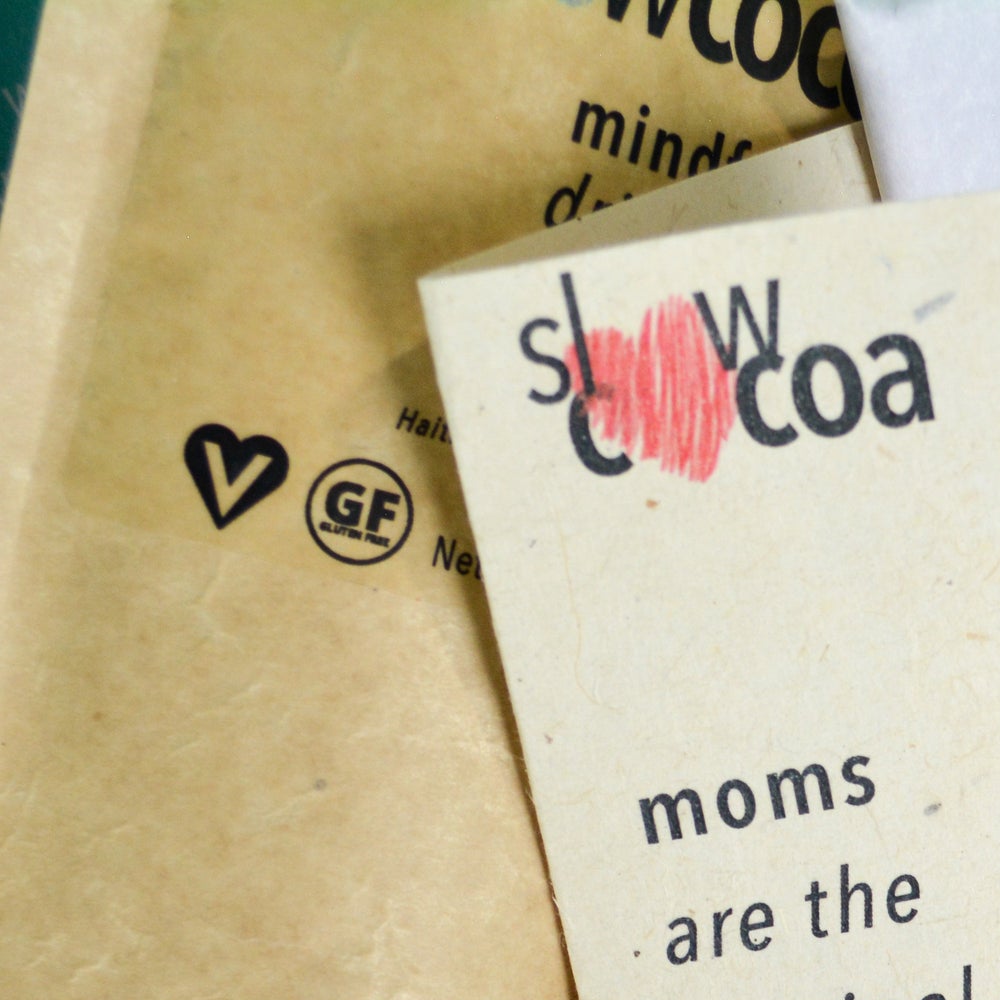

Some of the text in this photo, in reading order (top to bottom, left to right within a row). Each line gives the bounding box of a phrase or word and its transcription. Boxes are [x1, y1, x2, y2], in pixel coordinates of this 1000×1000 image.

[325, 481, 401, 533] GF
[639, 755, 876, 845] moms
[666, 863, 921, 966] are the
